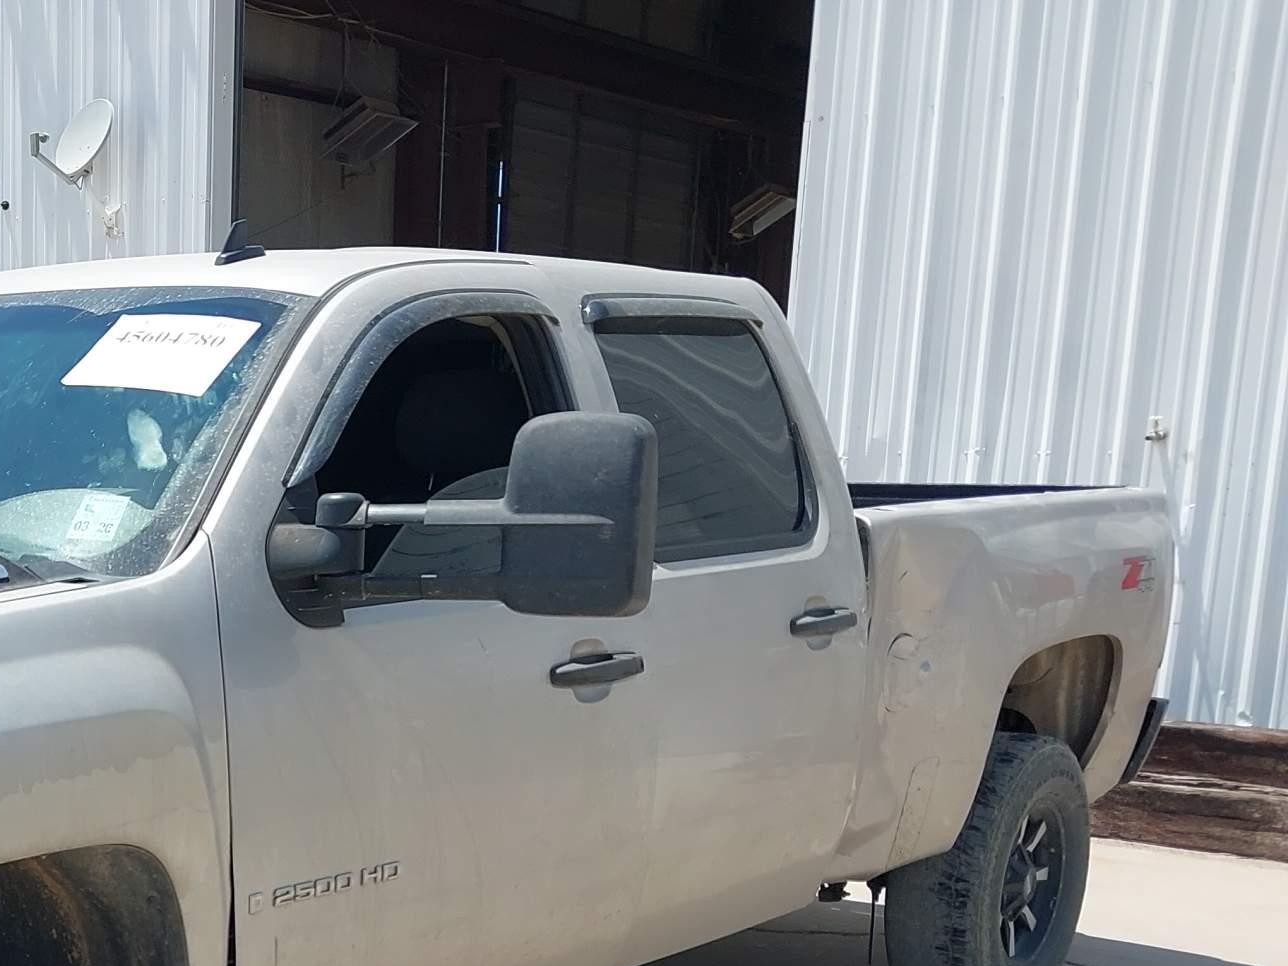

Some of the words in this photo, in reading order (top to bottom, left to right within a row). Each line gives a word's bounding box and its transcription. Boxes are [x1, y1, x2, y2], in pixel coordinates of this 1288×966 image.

[116, 331, 226, 348] 45604780
[73, 521, 89, 532] 03
[272, 872, 353, 907] 2500
[360, 860, 400, 886] HD
